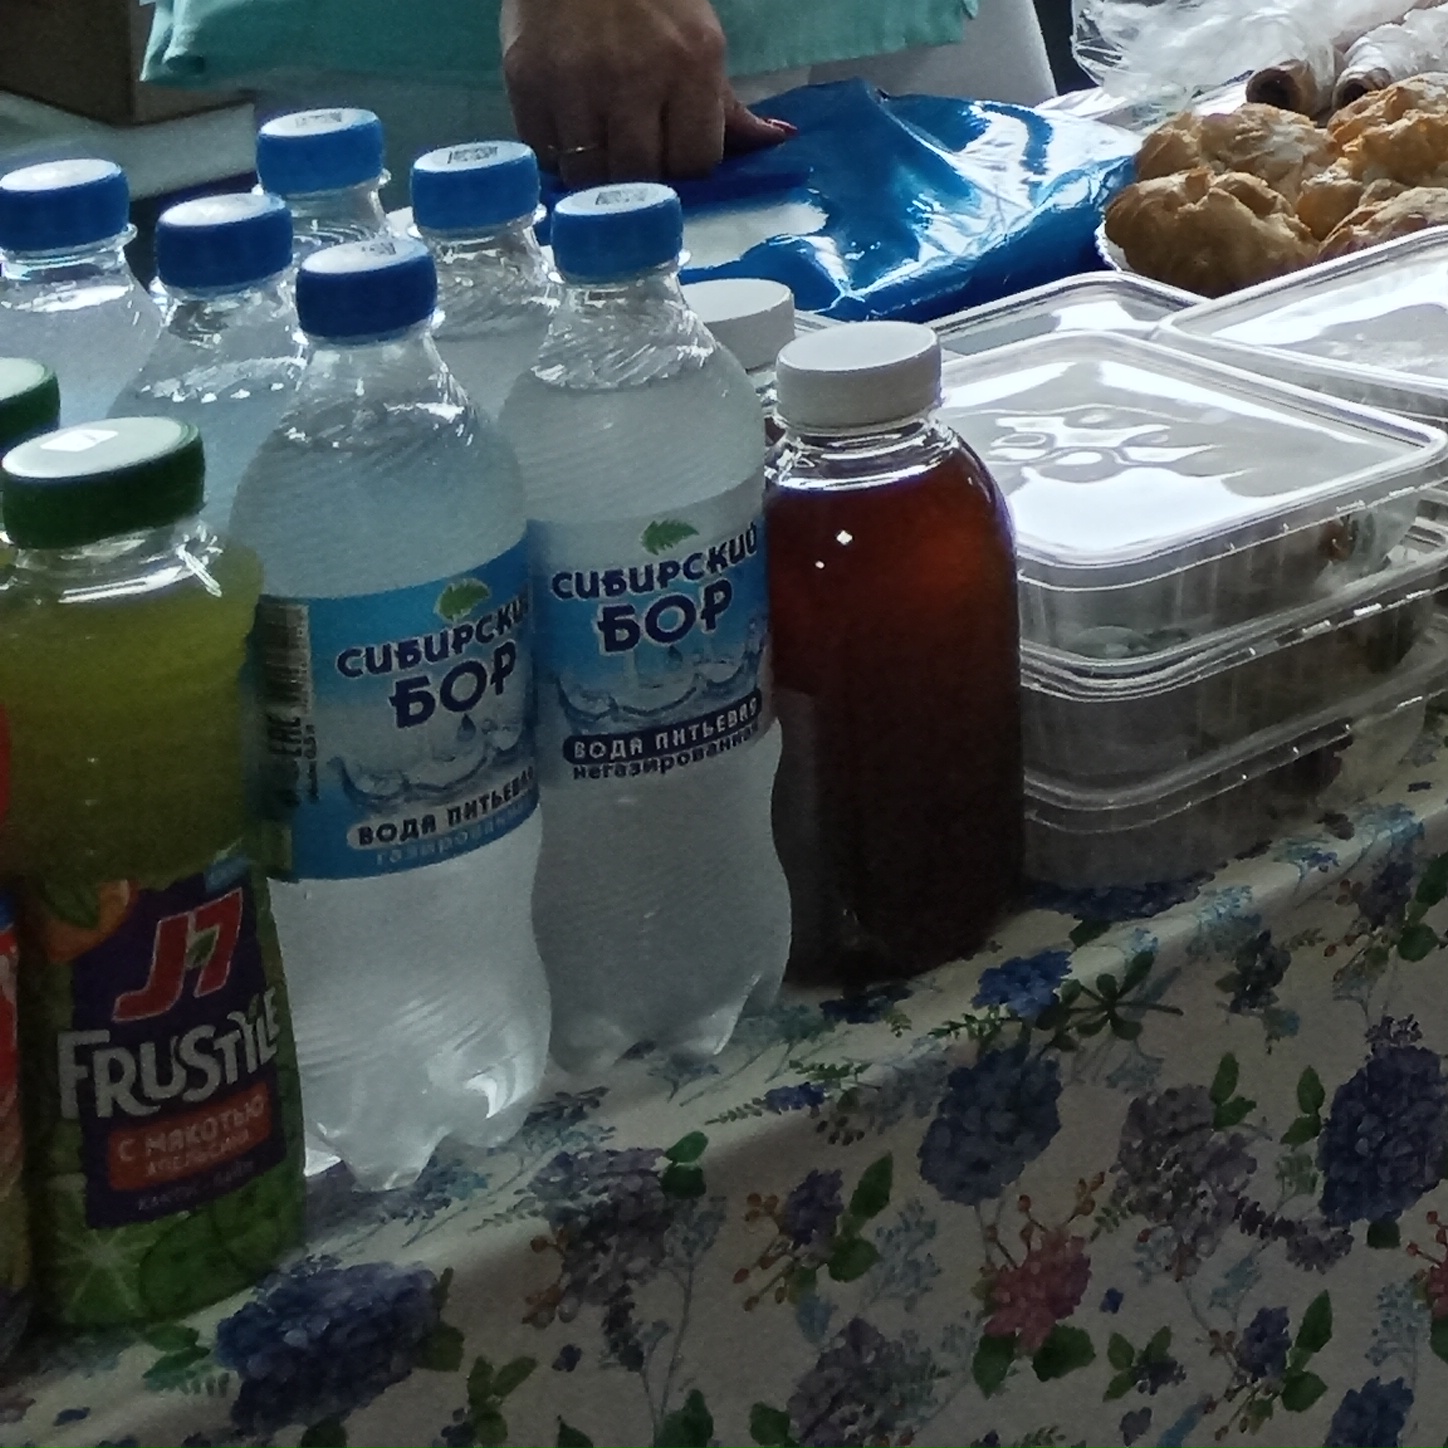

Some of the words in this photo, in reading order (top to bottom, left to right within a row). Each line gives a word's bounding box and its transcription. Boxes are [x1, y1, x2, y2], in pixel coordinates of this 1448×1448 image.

[551, 521, 758, 601] СИБИРСКИЙ
[337, 594, 530, 679] СИБИРСКИ
[597, 578, 733, 653] БОР
[389, 641, 517, 729] БОР
[573, 737, 644, 760] ВОДА
[654, 698, 758, 752] ПИТЬЕВАЯ
[357, 813, 437, 846] ВОДА
[112, 887, 244, 1023] J7
